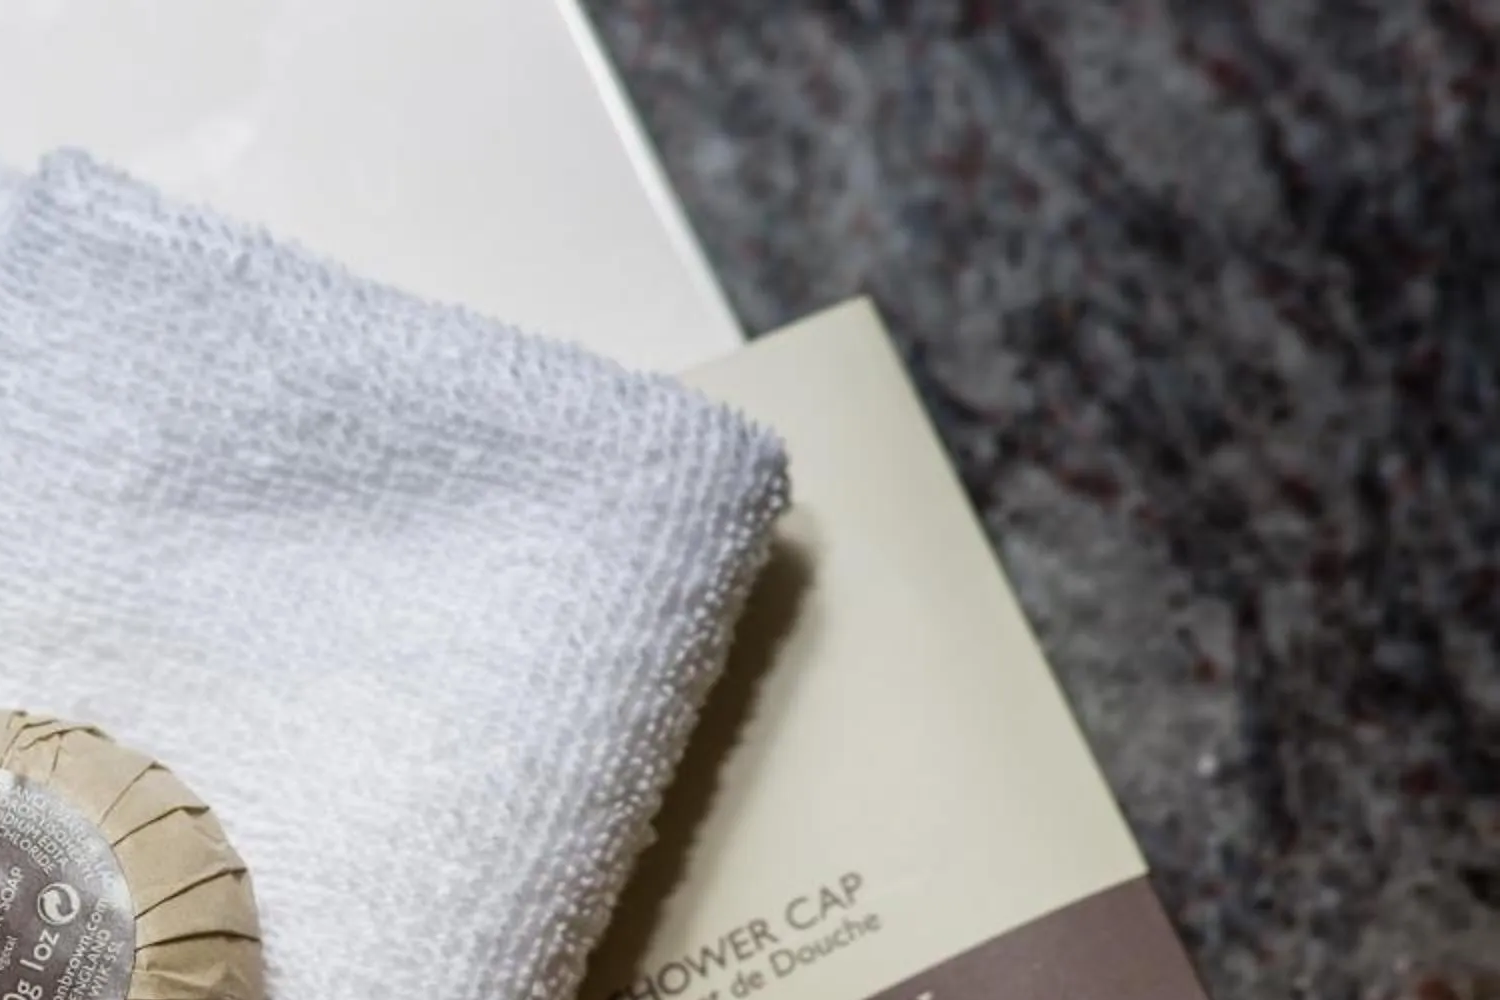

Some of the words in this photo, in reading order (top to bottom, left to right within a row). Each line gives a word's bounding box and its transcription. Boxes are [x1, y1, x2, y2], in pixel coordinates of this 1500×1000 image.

[784, 872, 864, 930] CAP
[20, 929, 60, 971] 1oz
[731, 966, 767, 999] de
[769, 911, 883, 979] Douche
